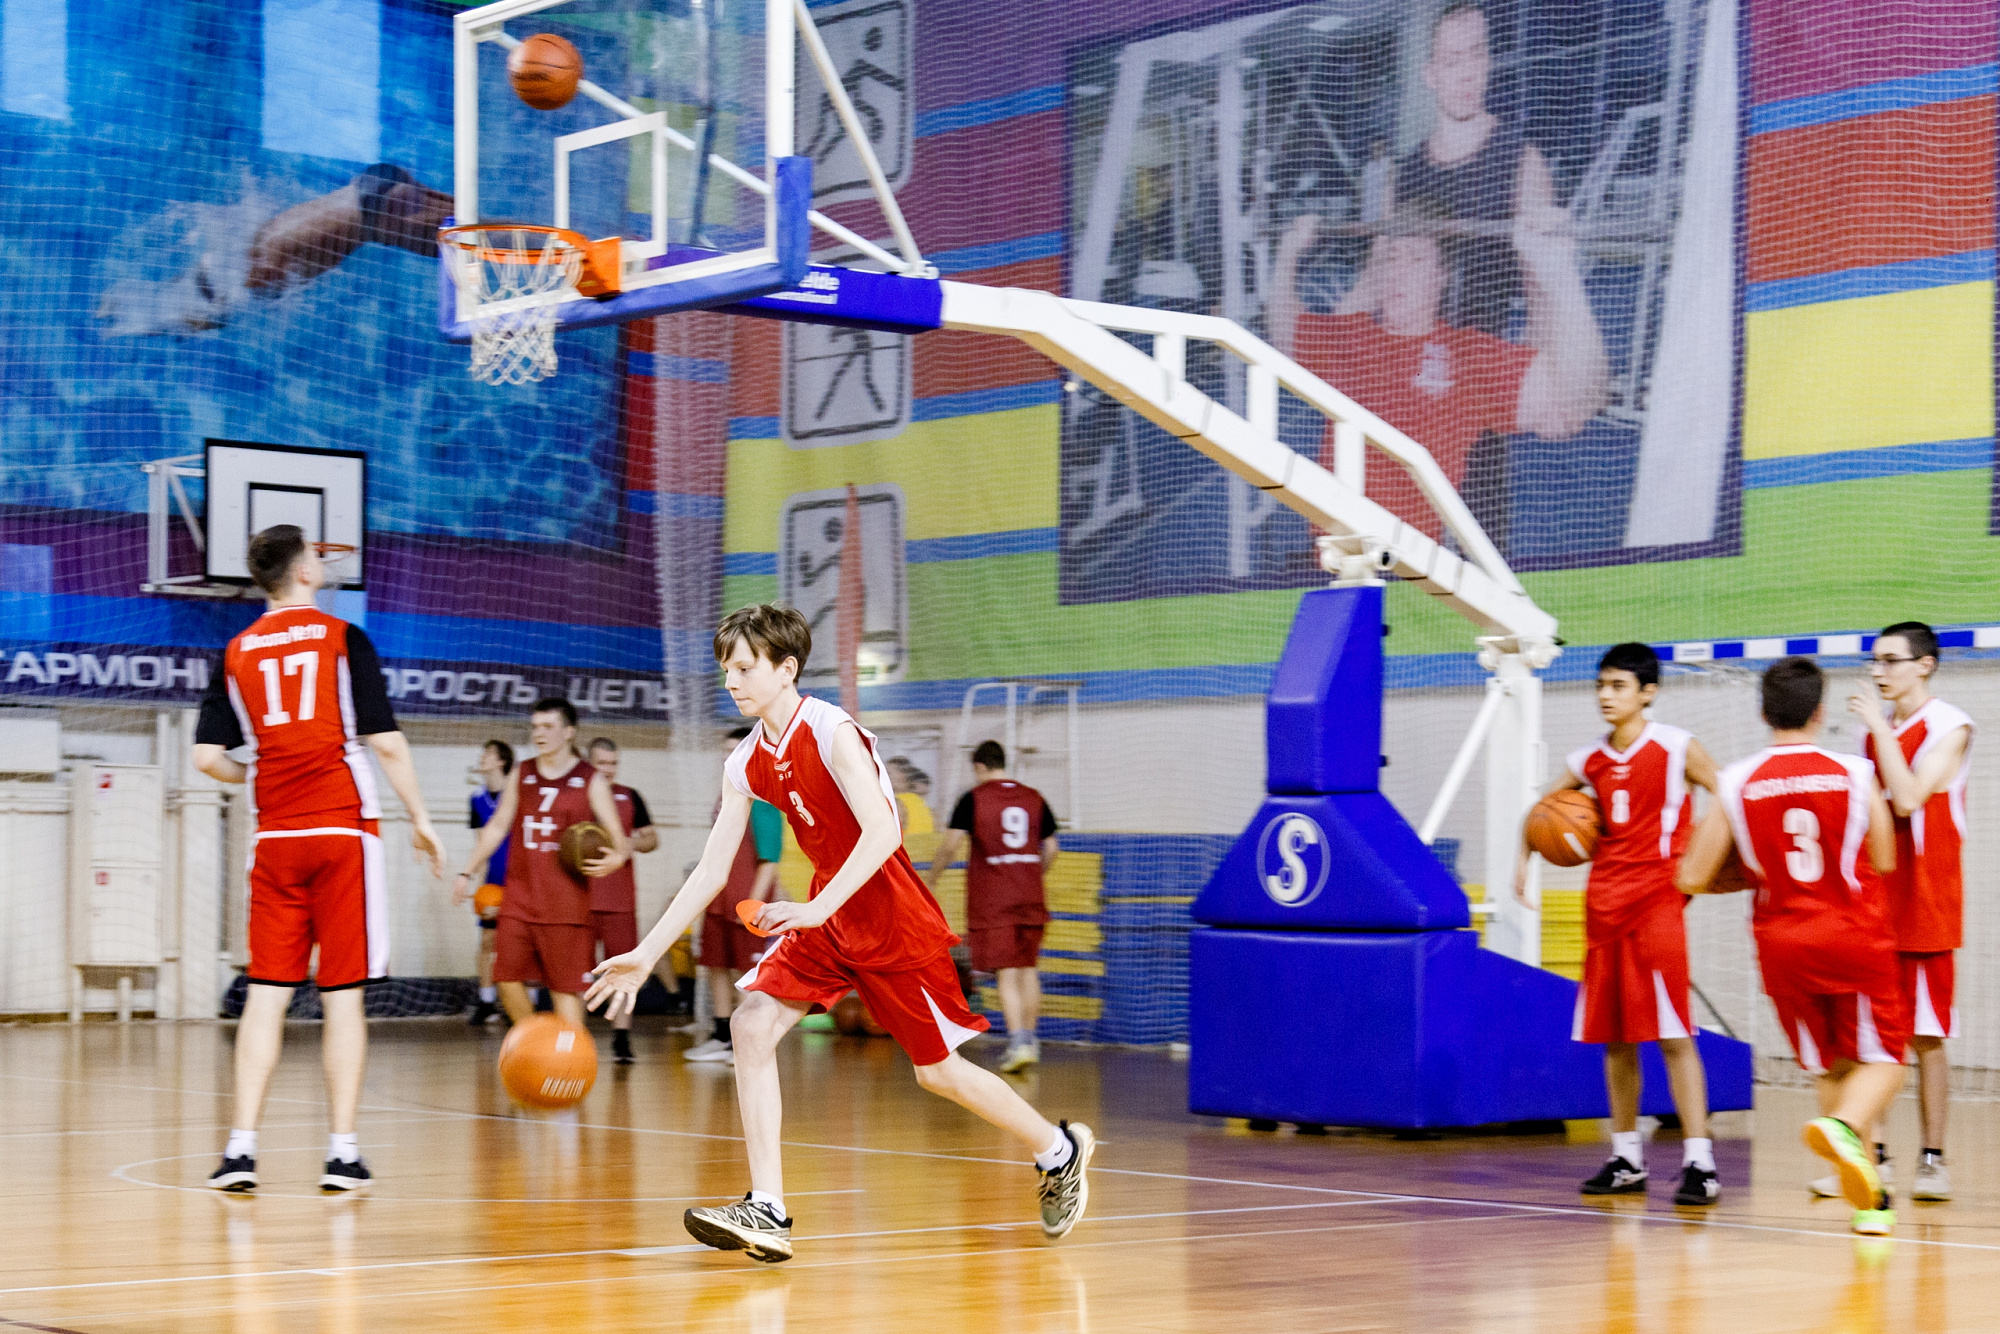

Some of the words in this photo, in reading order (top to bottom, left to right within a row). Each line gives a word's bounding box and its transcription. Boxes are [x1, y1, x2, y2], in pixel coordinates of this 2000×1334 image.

[0, 650, 210, 690] АРМОН
[257, 651, 319, 726] 17
[538, 786, 559, 812] 7
[788, 790, 815, 827] 3
[1001, 806, 1029, 849] 9
[1782, 807, 1825, 883] 3
